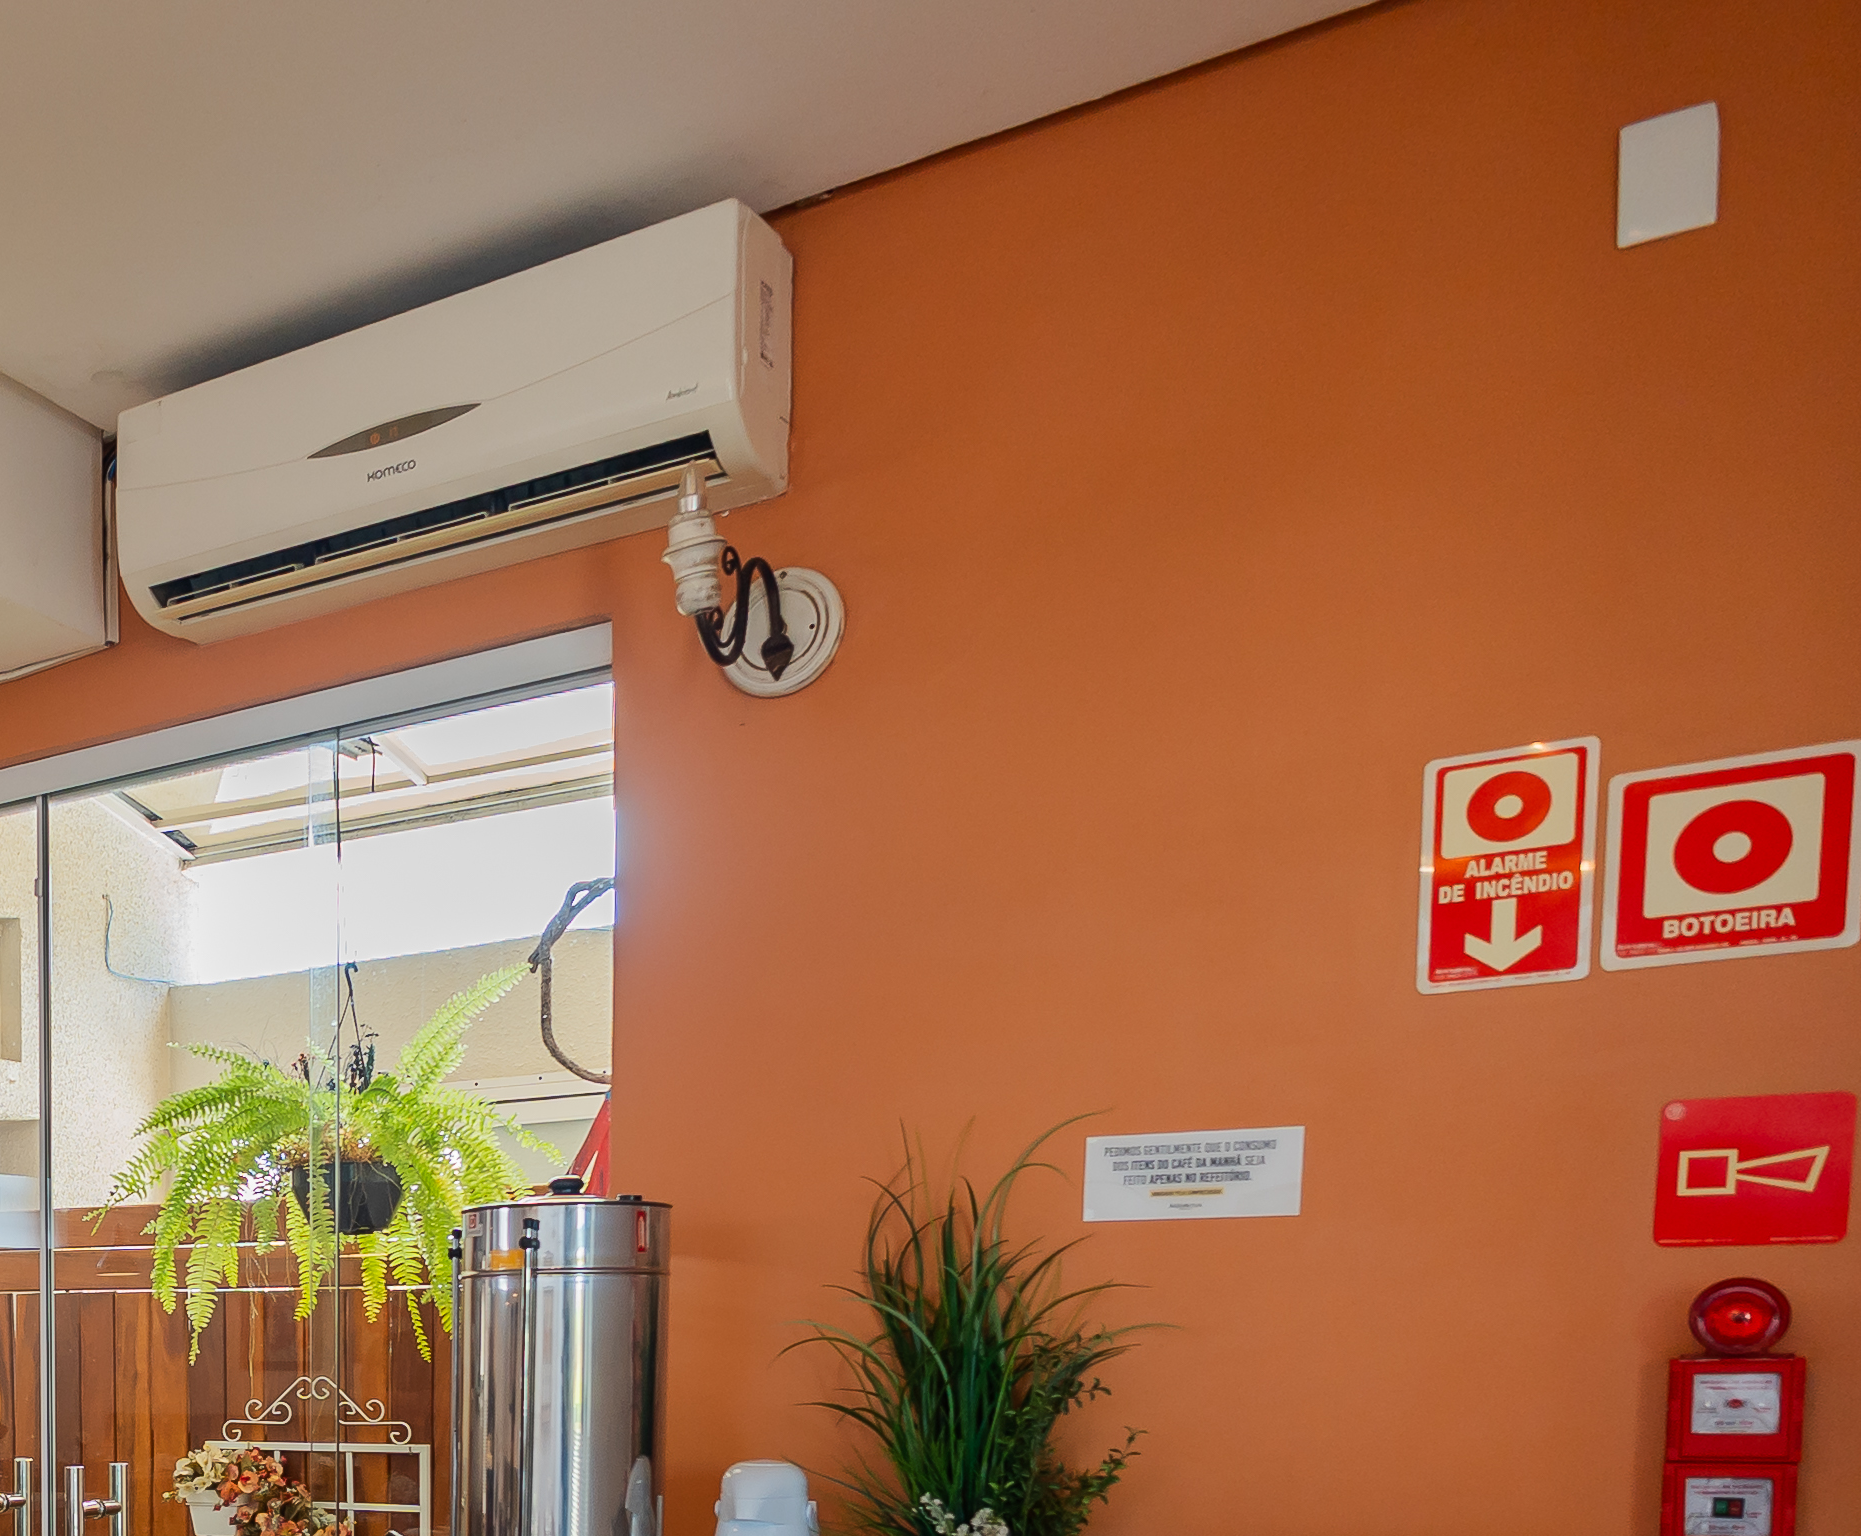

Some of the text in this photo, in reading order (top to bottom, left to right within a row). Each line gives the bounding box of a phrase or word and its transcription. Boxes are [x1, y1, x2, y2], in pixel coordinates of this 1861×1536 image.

[1464, 850, 1548, 879] ALARME
[1438, 871, 1574, 904] DE INCÊNDIO
[1662, 907, 1796, 939] BOTOEIRA
[1171, 1156, 1193, 1169] CAFÉ
[1195, 1157, 1207, 1168] DA
[1148, 1173, 1183, 1185] APENAS
